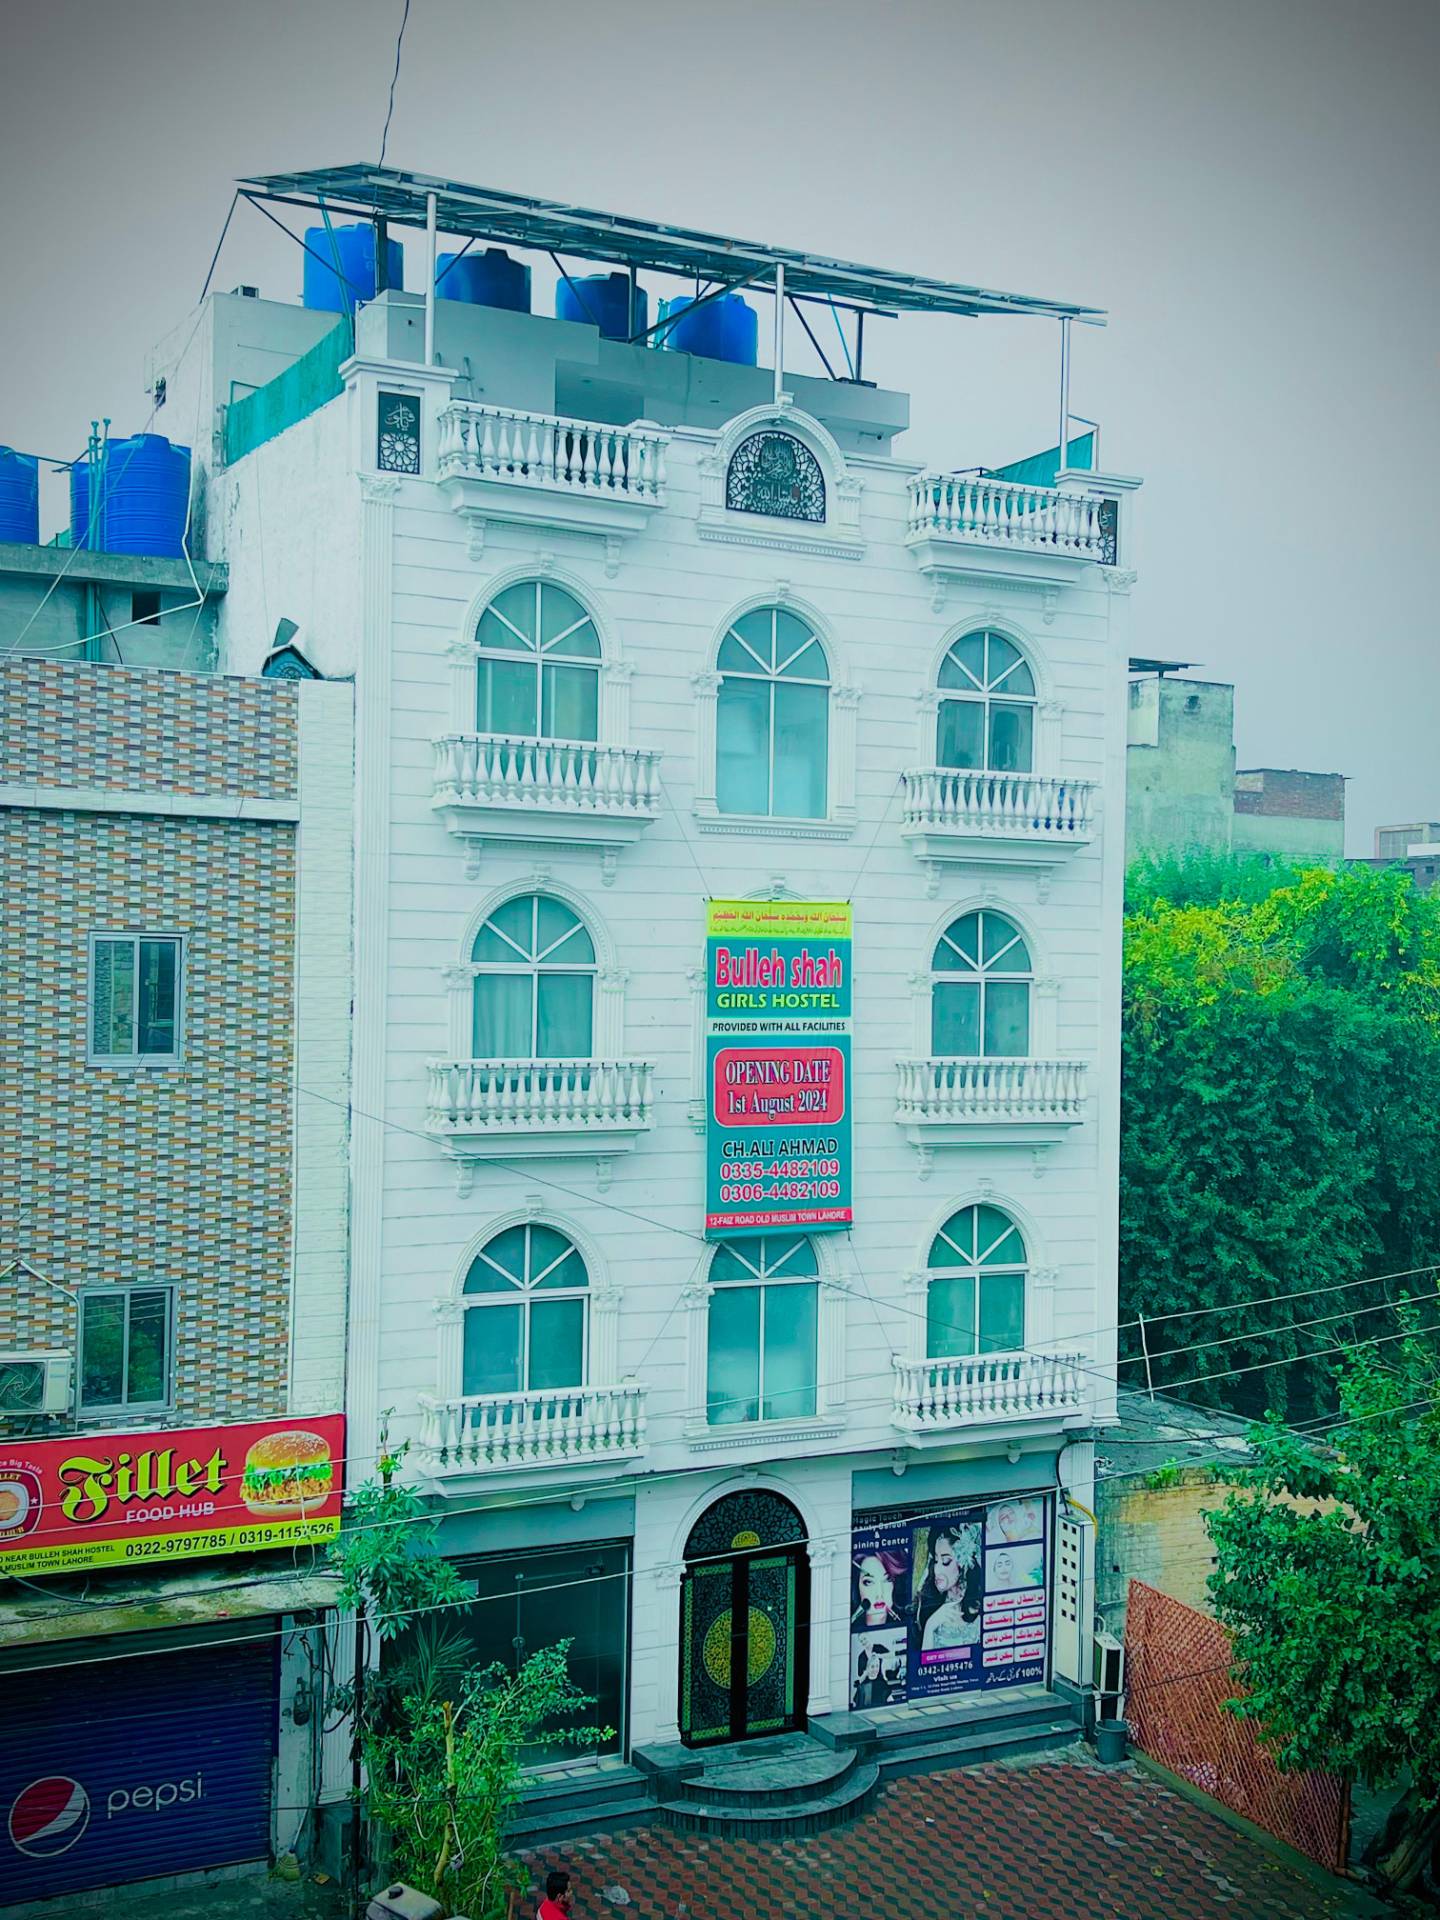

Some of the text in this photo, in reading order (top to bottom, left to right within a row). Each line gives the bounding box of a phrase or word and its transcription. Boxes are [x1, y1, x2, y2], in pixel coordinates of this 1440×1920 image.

[715, 947, 842, 988] Bulleh shah
[717, 993, 840, 1008] GIRLS HOSTEL
[713, 1022, 846, 1032] PROVIDED WITH ALL FACILITIES
[725, 1059, 831, 1084] OPENING DATE
[728, 1089, 827, 1120] 1st August 2024
[722, 1138, 838, 1157] CH.ALI AHMAD
[720, 1159, 839, 1180] 0335-4482109
[720, 1181, 840, 1203] 0306-4482109
[710, 1210, 846, 1226] 12-FAIZ ROAD OLD MUSLIM TOWN LAHORE
[57, 1447, 229, 1522] Fillet
[126, 1502, 215, 1523] FOOD HUB
[126, 1533, 227, 1558] 0322-9797785
[881, 1537, 909, 1547] Center
[5, 1562, 35, 1571] MUSLIM
[37, 1559, 60, 1568] TOWN
[62, 1556, 93, 1566] LAHORE
[6, 1553, 27, 1562] NEAR
[29, 1551, 60, 1561] BULLEH
[62, 1548, 84, 1557] SHAH
[85, 1545, 115, 1555] HOSTEL
[107, 1771, 202, 1819] pepsi
